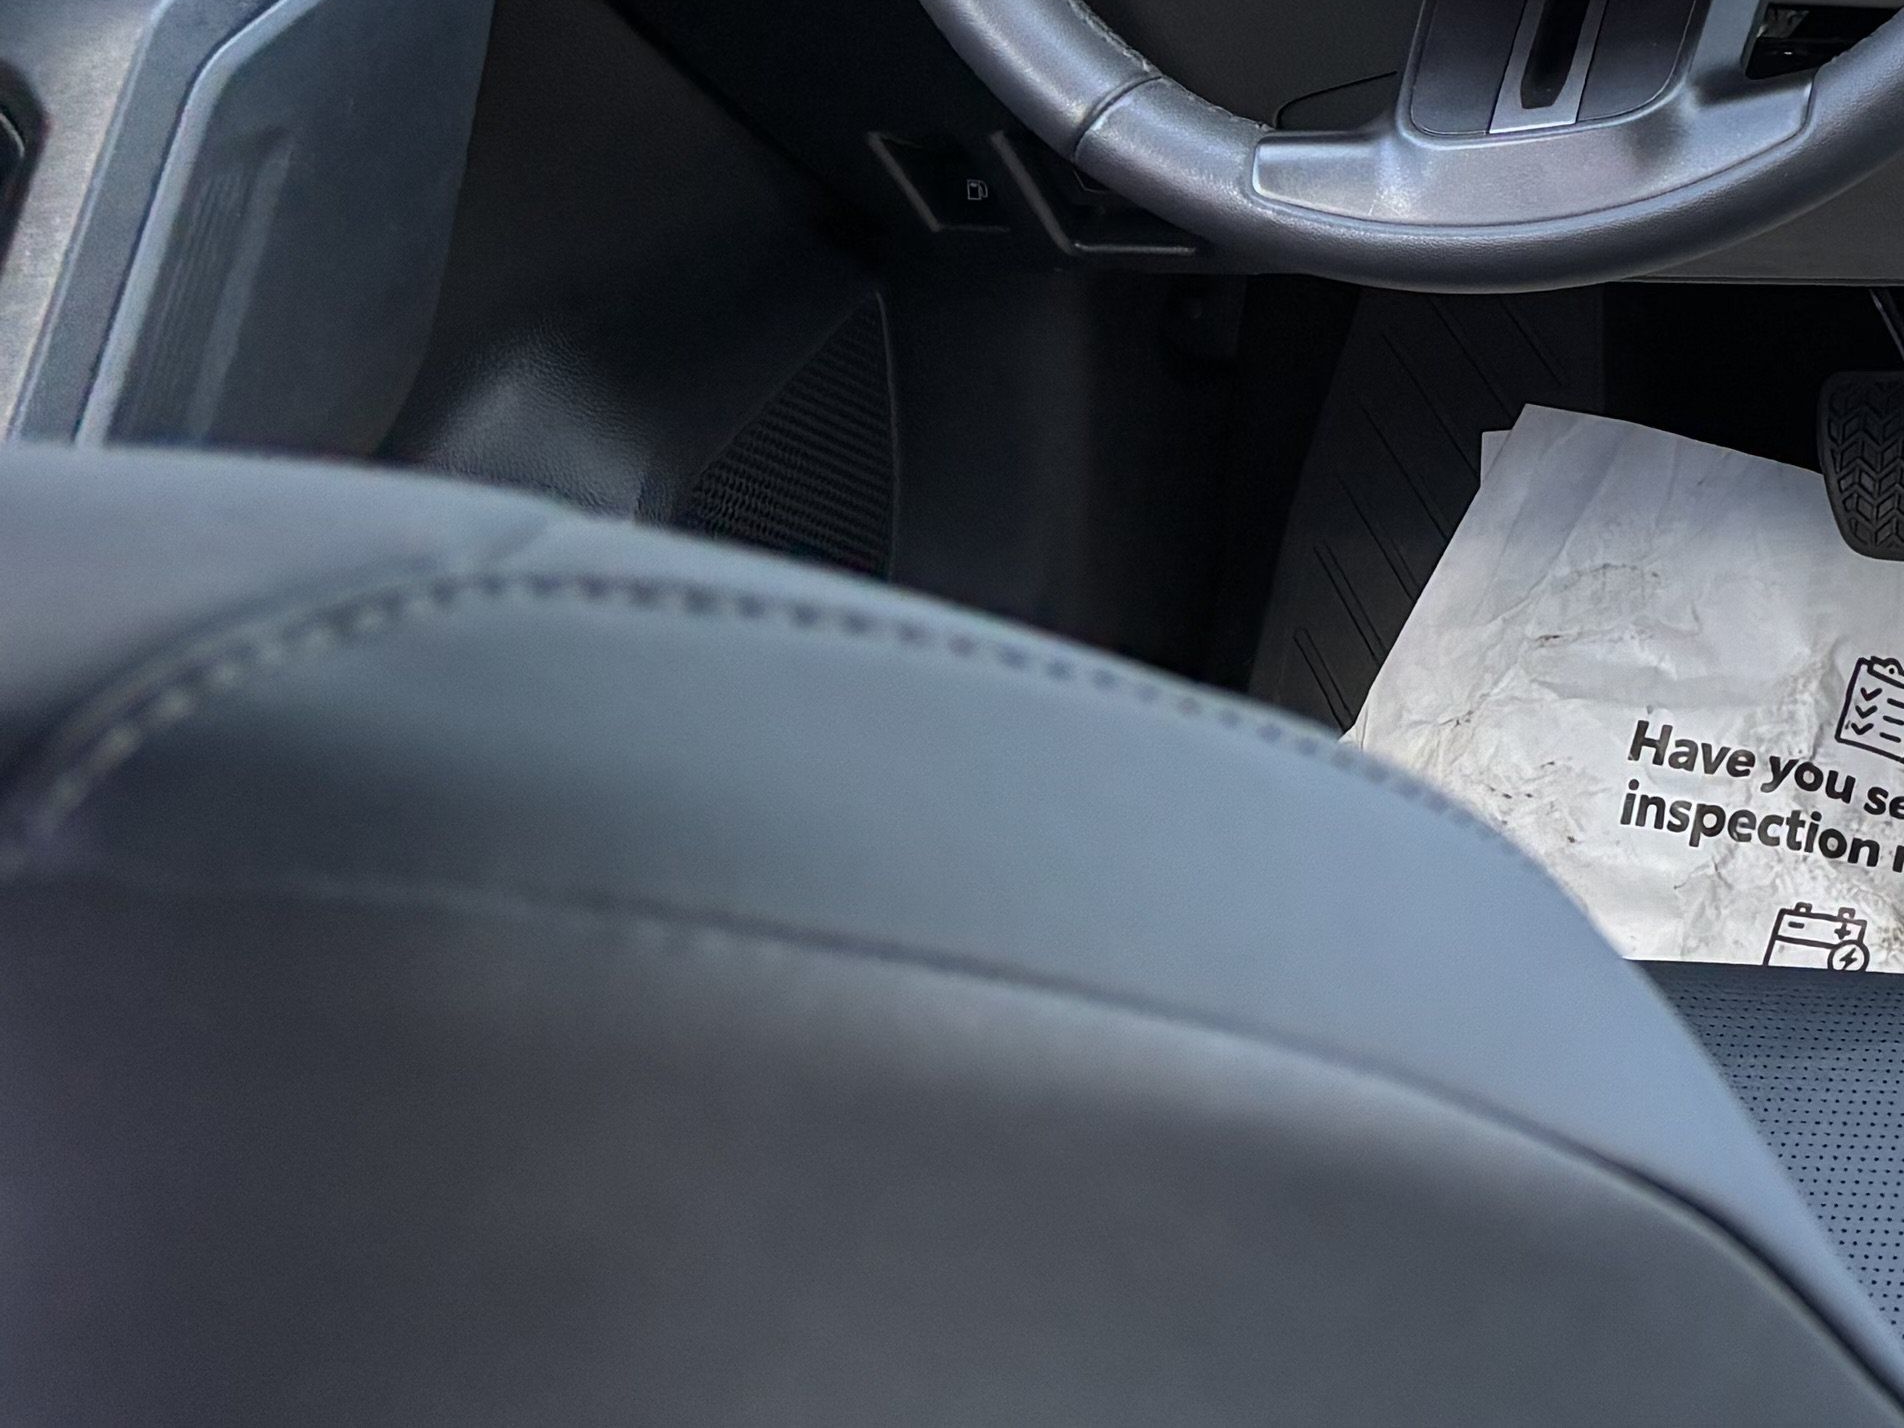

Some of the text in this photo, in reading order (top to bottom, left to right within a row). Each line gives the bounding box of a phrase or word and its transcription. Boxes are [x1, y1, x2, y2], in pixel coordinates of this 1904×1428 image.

[1627, 719, 1757, 779] Have
[1761, 754, 1858, 805] you
[1619, 779, 1881, 869] inspection
